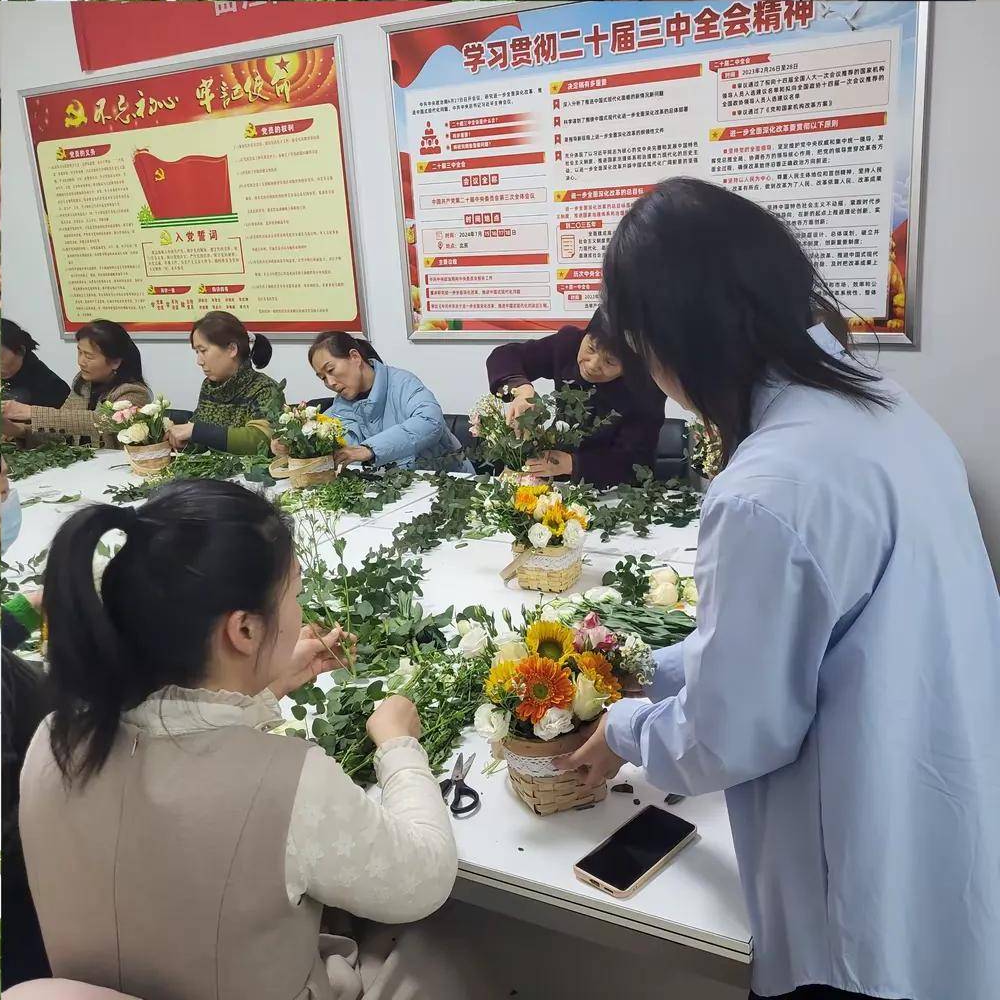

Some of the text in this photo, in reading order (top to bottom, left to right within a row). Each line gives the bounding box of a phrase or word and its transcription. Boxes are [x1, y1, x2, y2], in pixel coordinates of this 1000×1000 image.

[463, 1, 815, 74] 学习贯彻二十届三中全会精神
[713, 57, 751, 68] 二十届二中全会
[742, 64, 799, 76] 2023年2月26日至28日
[92, 89, 180, 126] 不忘初心
[465, 213, 500, 224] 时间地点
[175, 229, 218, 242] 入党誓词
[573, 270, 604, 278] 历次中央全
